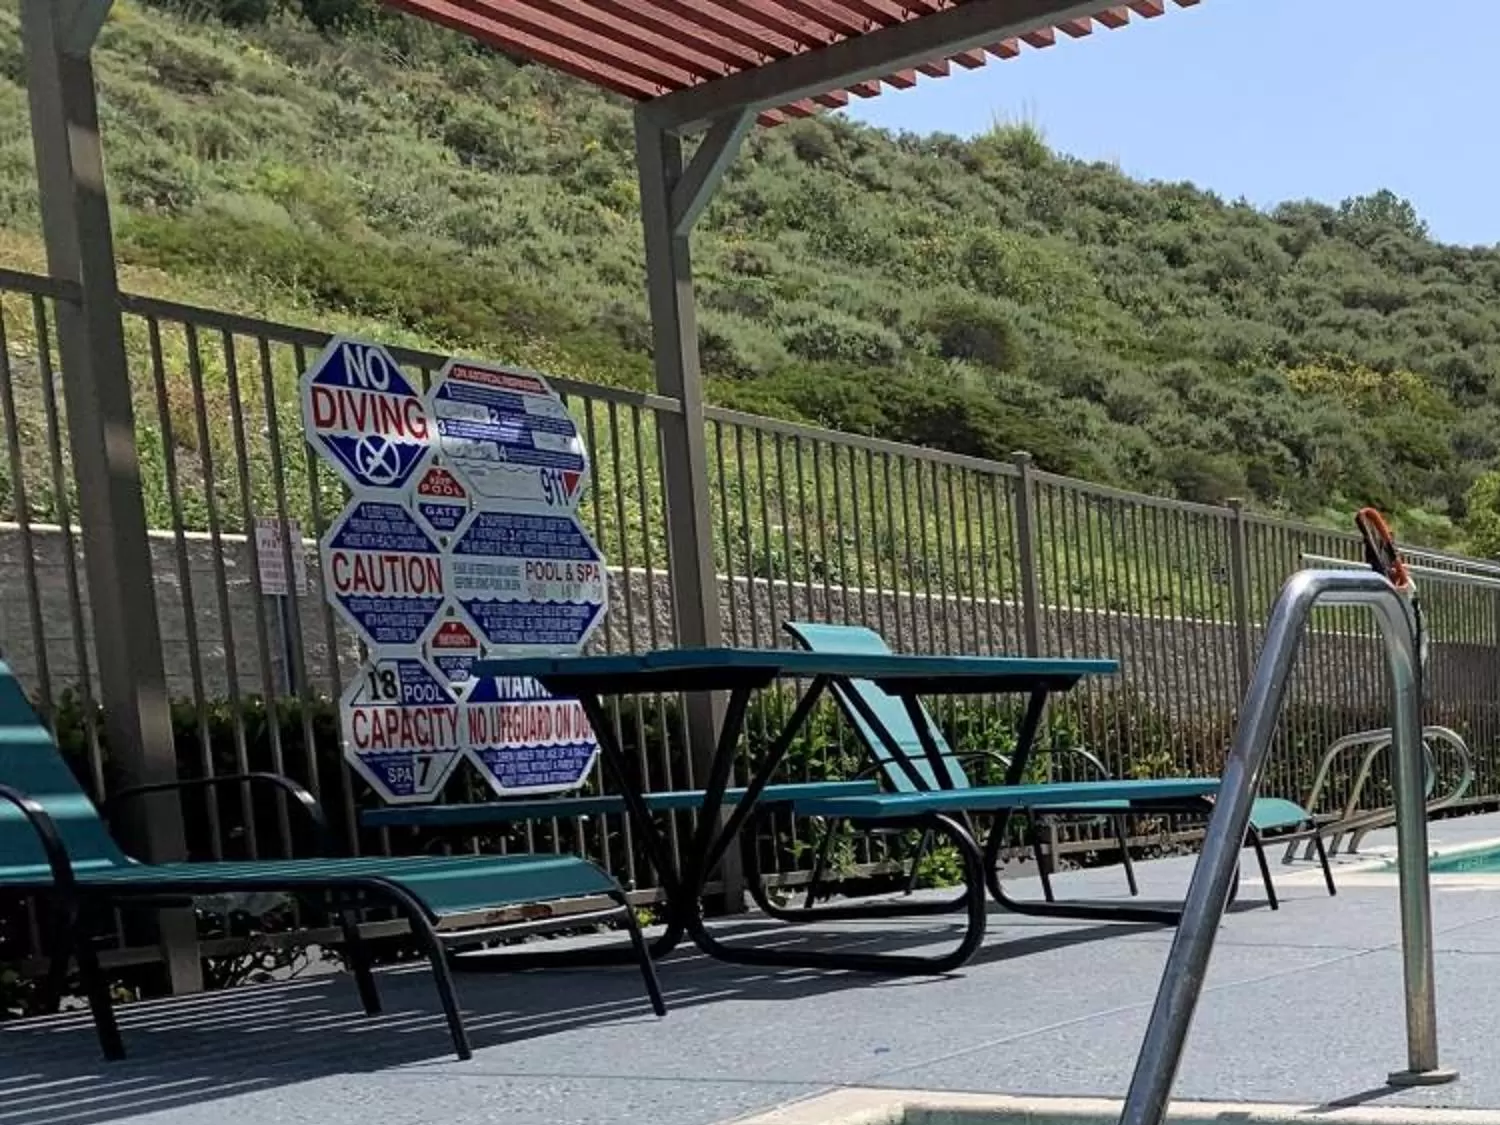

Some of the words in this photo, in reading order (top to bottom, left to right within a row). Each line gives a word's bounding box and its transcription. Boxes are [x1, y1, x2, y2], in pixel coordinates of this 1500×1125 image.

[342, 343, 390, 391] NO
[311, 386, 429, 440] DIVING
[420, 483, 463, 497] POOL
[539, 467, 569, 507] 911
[425, 506, 459, 517] GATE
[332, 552, 444, 594] CAUTION
[525, 560, 562, 582] POOL
[565, 563, 574, 582] &
[576, 563, 601, 583] SPA
[368, 670, 399, 700] 18
[403, 683, 444, 702] POOL
[352, 706, 459, 750] CAPACITY
[468, 707, 487, 745] NO
[490, 704, 553, 744] LIFEGUARD
[555, 703, 571, 739] ON
[387, 767, 413, 783] SPA
[416, 756, 432, 787] 7
